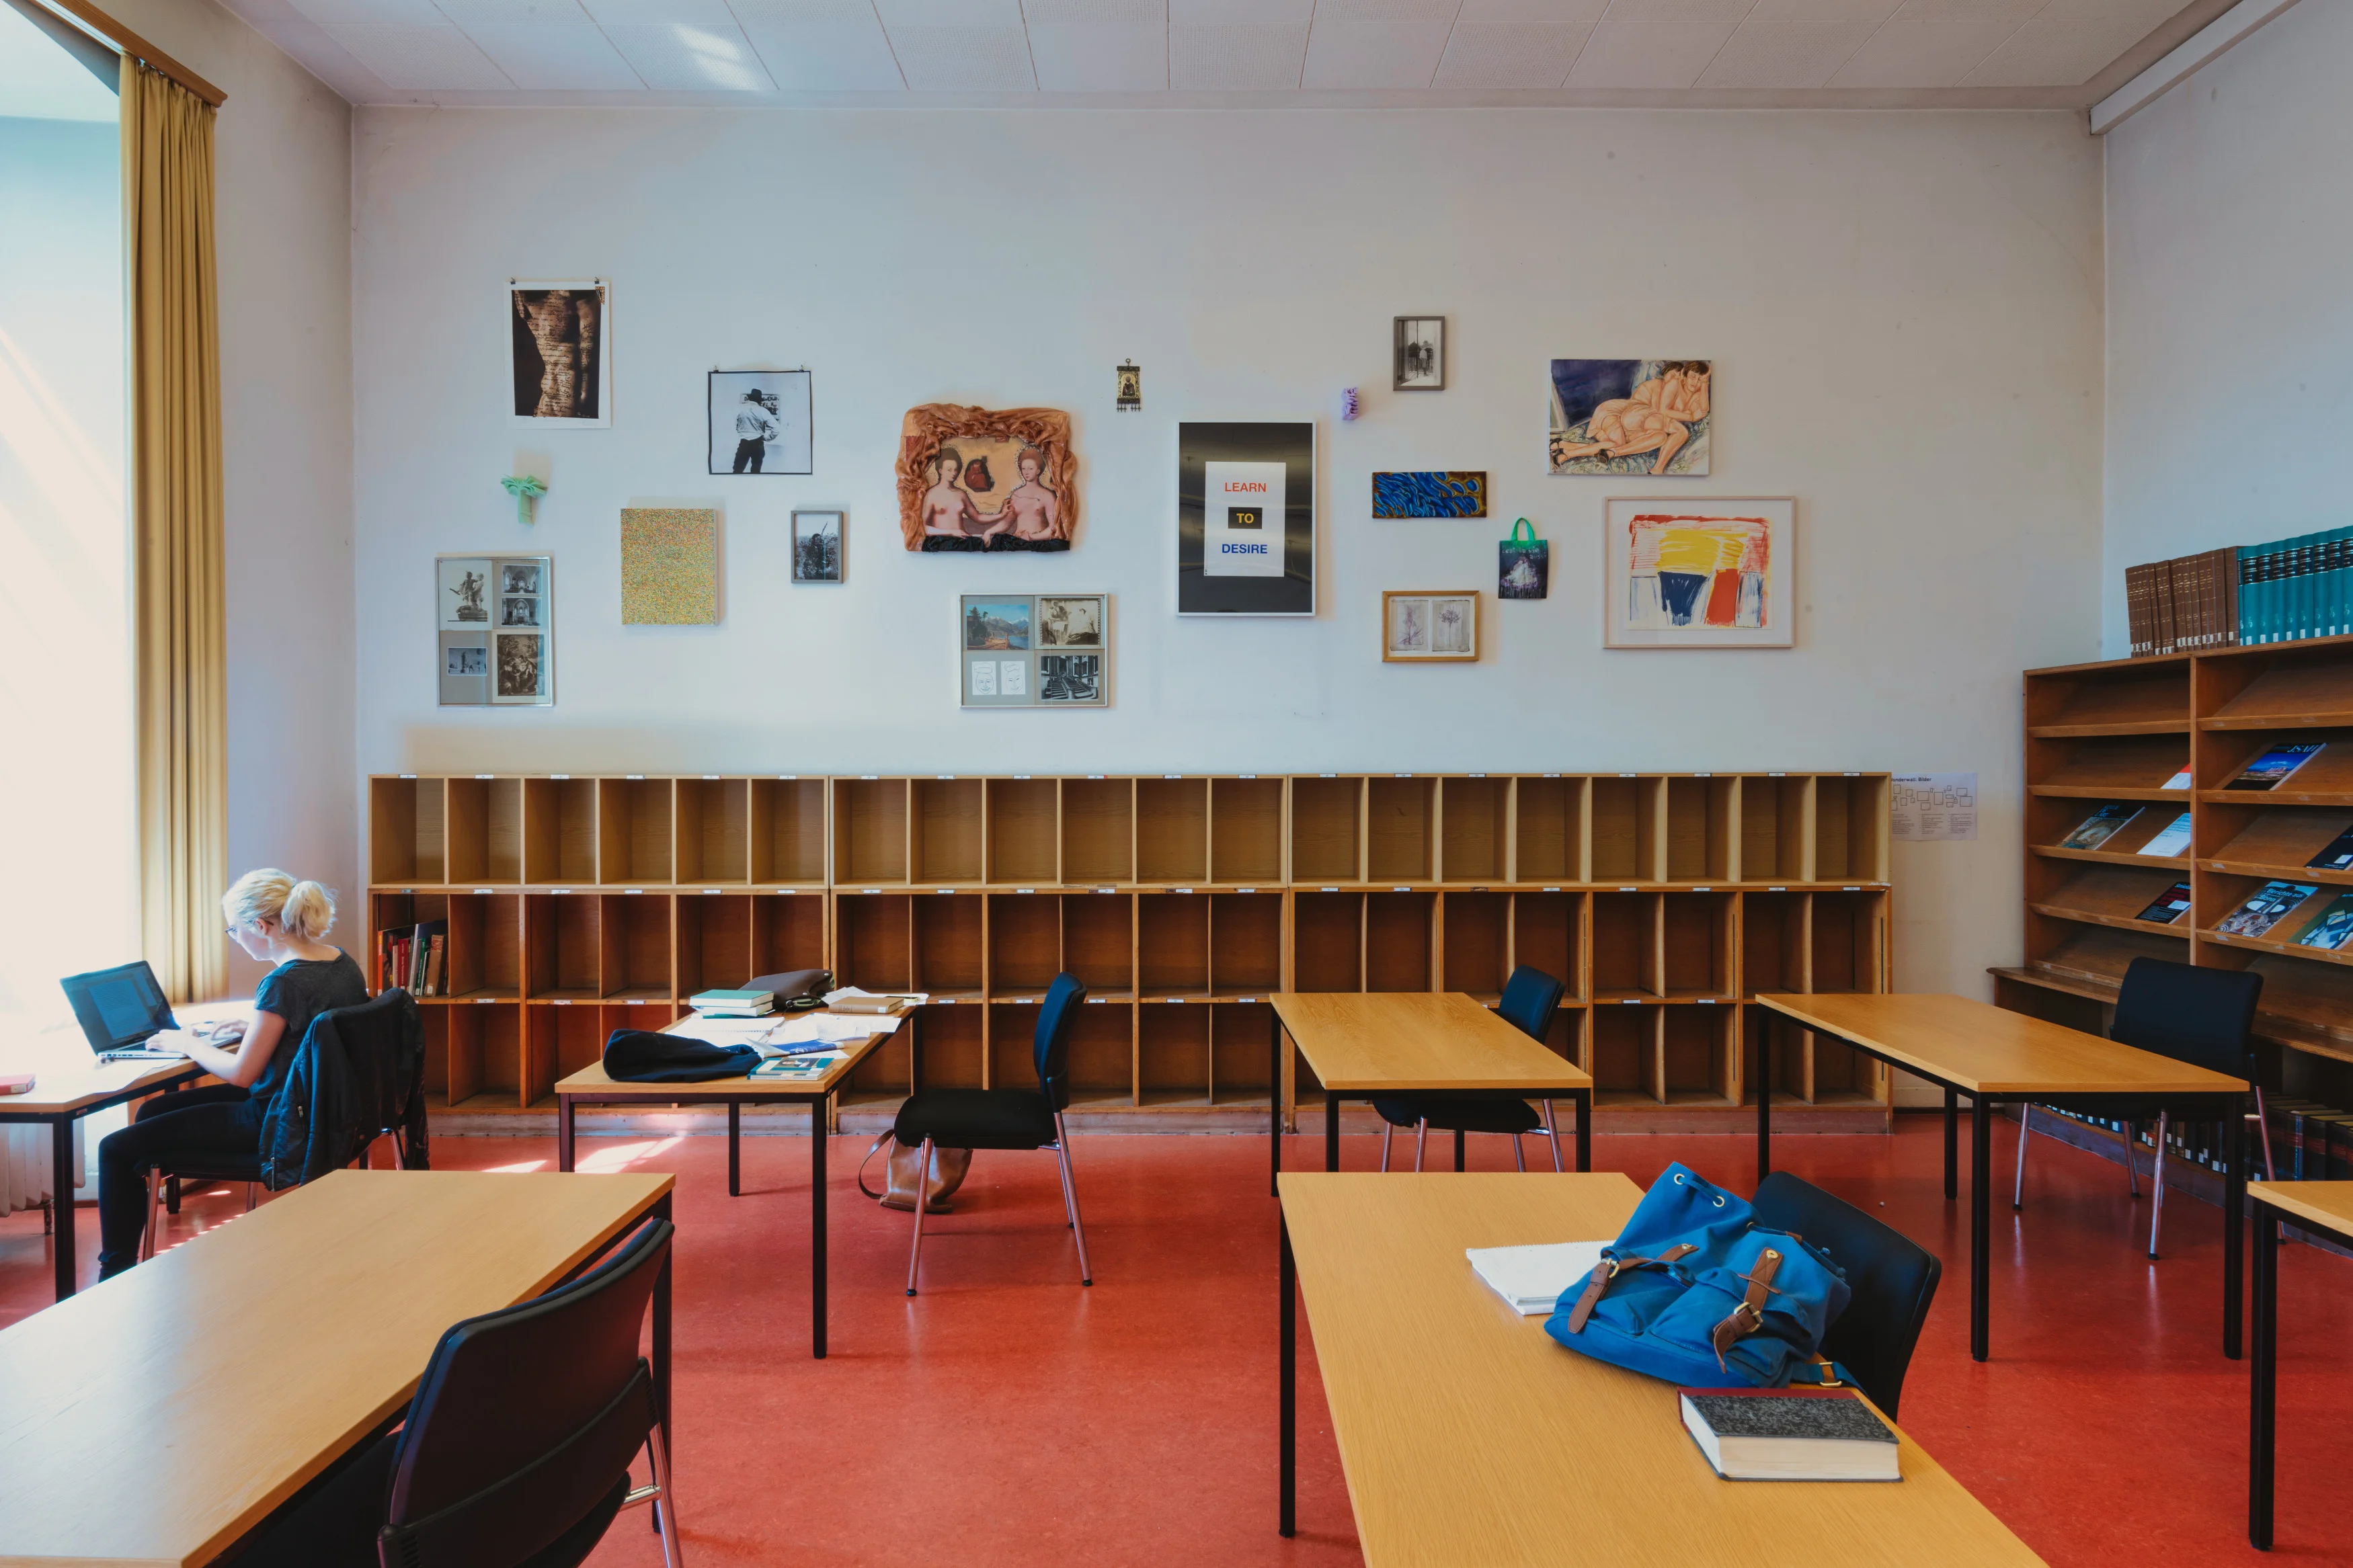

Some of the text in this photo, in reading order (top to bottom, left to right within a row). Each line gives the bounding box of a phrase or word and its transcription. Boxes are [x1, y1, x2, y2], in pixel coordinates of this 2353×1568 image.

[1225, 483, 1267, 492] LEARN
[1236, 513, 1254, 523] TO
[1222, 544, 1267, 554] DESIRE
